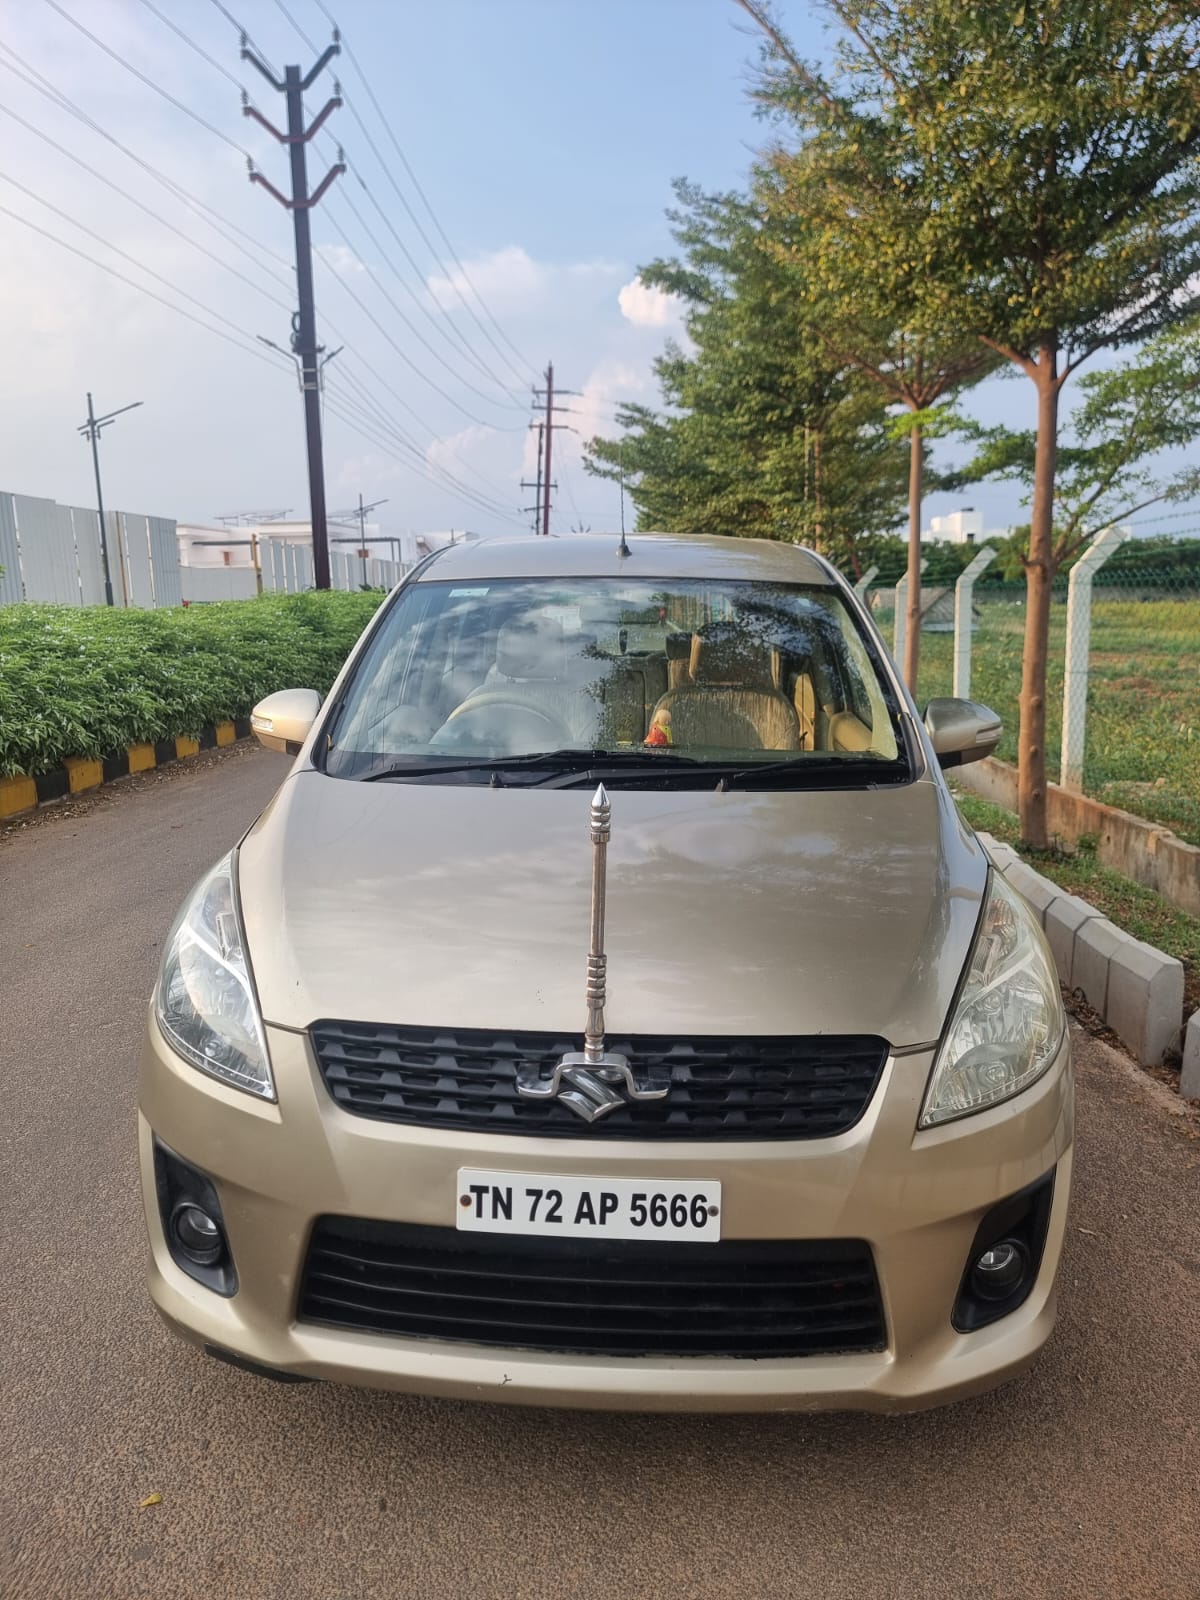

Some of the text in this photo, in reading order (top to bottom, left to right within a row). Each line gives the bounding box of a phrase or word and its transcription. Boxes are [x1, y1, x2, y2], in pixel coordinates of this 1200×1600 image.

[470, 1184, 708, 1228] TN 72 AP 5666
